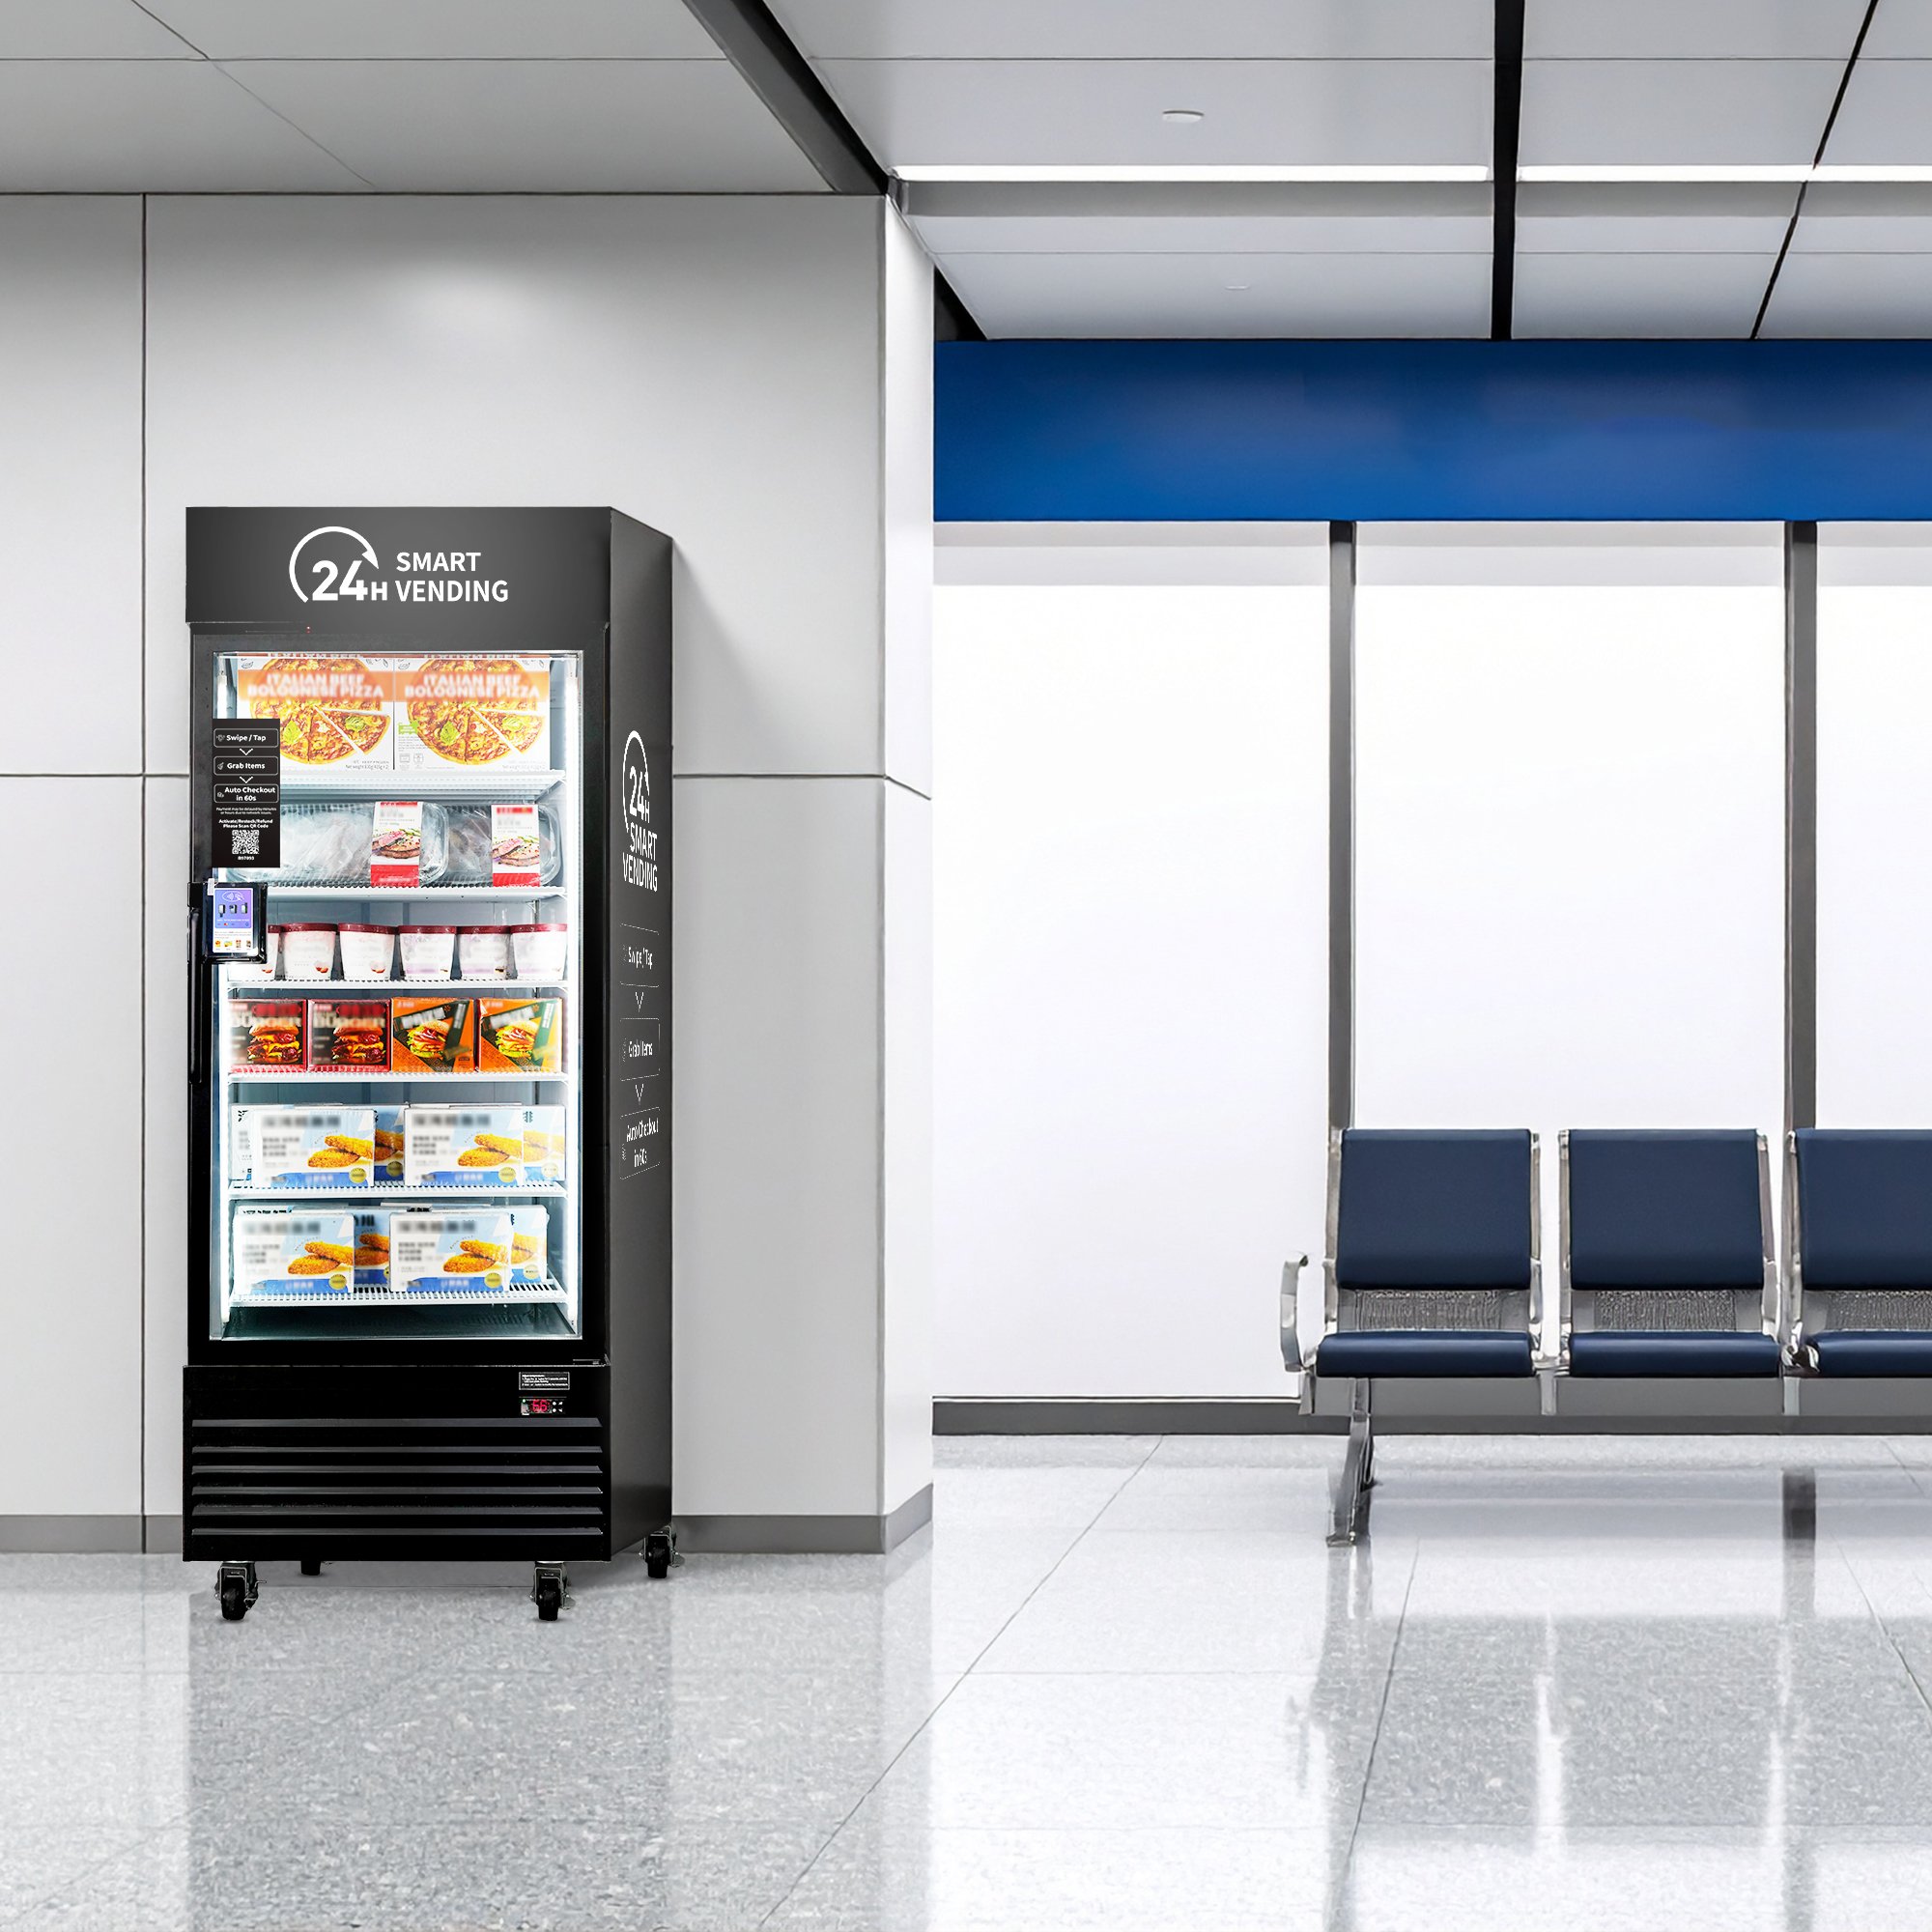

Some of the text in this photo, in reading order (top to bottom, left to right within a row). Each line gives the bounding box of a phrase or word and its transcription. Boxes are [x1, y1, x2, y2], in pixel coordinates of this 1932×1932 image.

[312, 560, 387, 601] 24H
[396, 552, 481, 572] SMART
[395, 580, 508, 602] VENDING
[629, 766, 650, 823] 24H
[630, 822, 658, 861] SMART
[623, 852, 658, 892] VENDING
